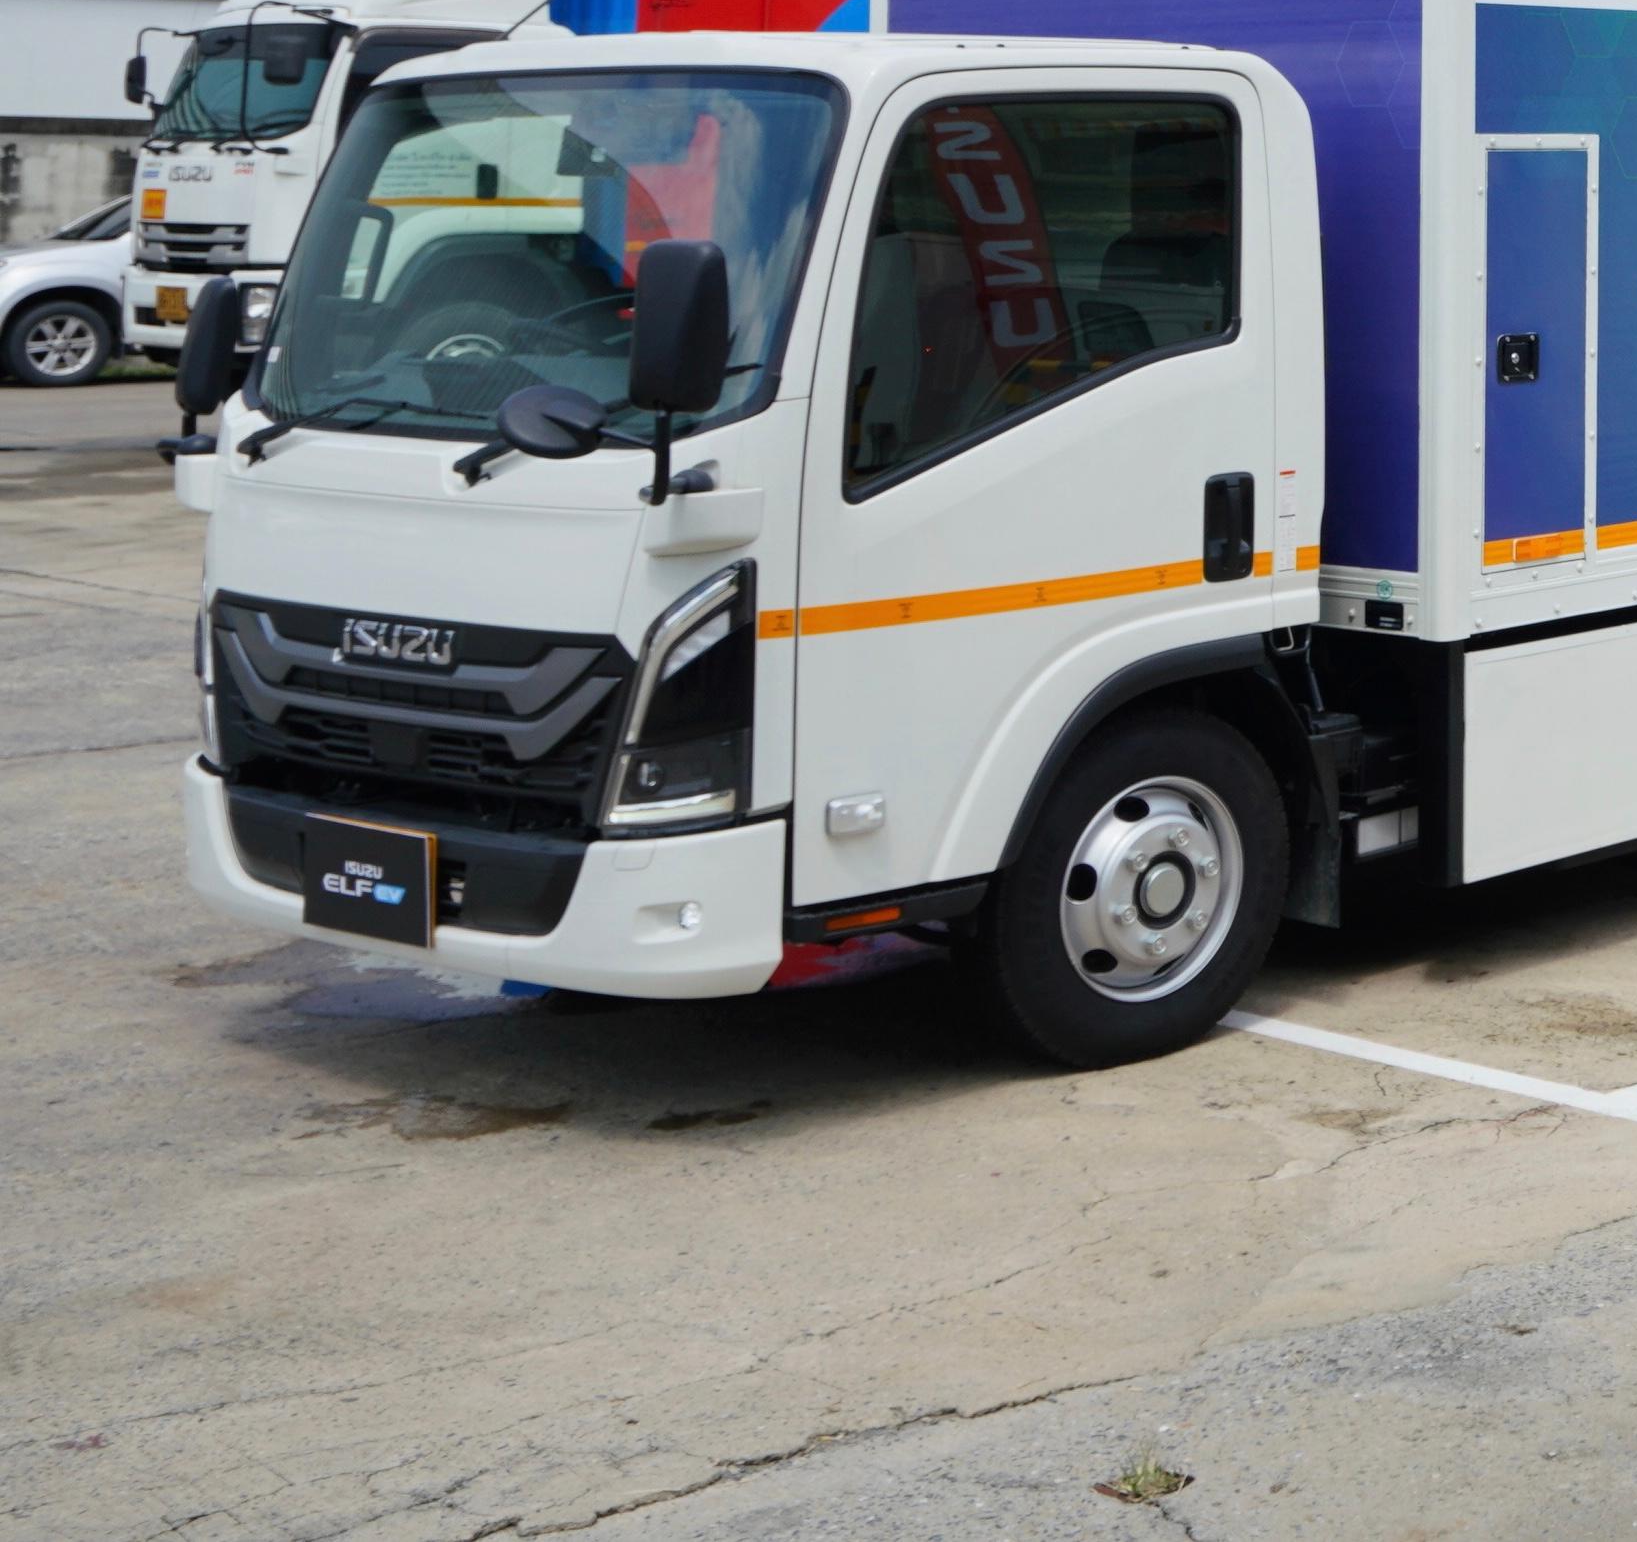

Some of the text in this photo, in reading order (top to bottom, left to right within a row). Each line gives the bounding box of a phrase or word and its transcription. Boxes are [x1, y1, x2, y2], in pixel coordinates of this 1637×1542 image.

[343, 618, 456, 666] ISUZU
[345, 860, 383, 880] ISUZU
[323, 873, 373, 897] ELF
